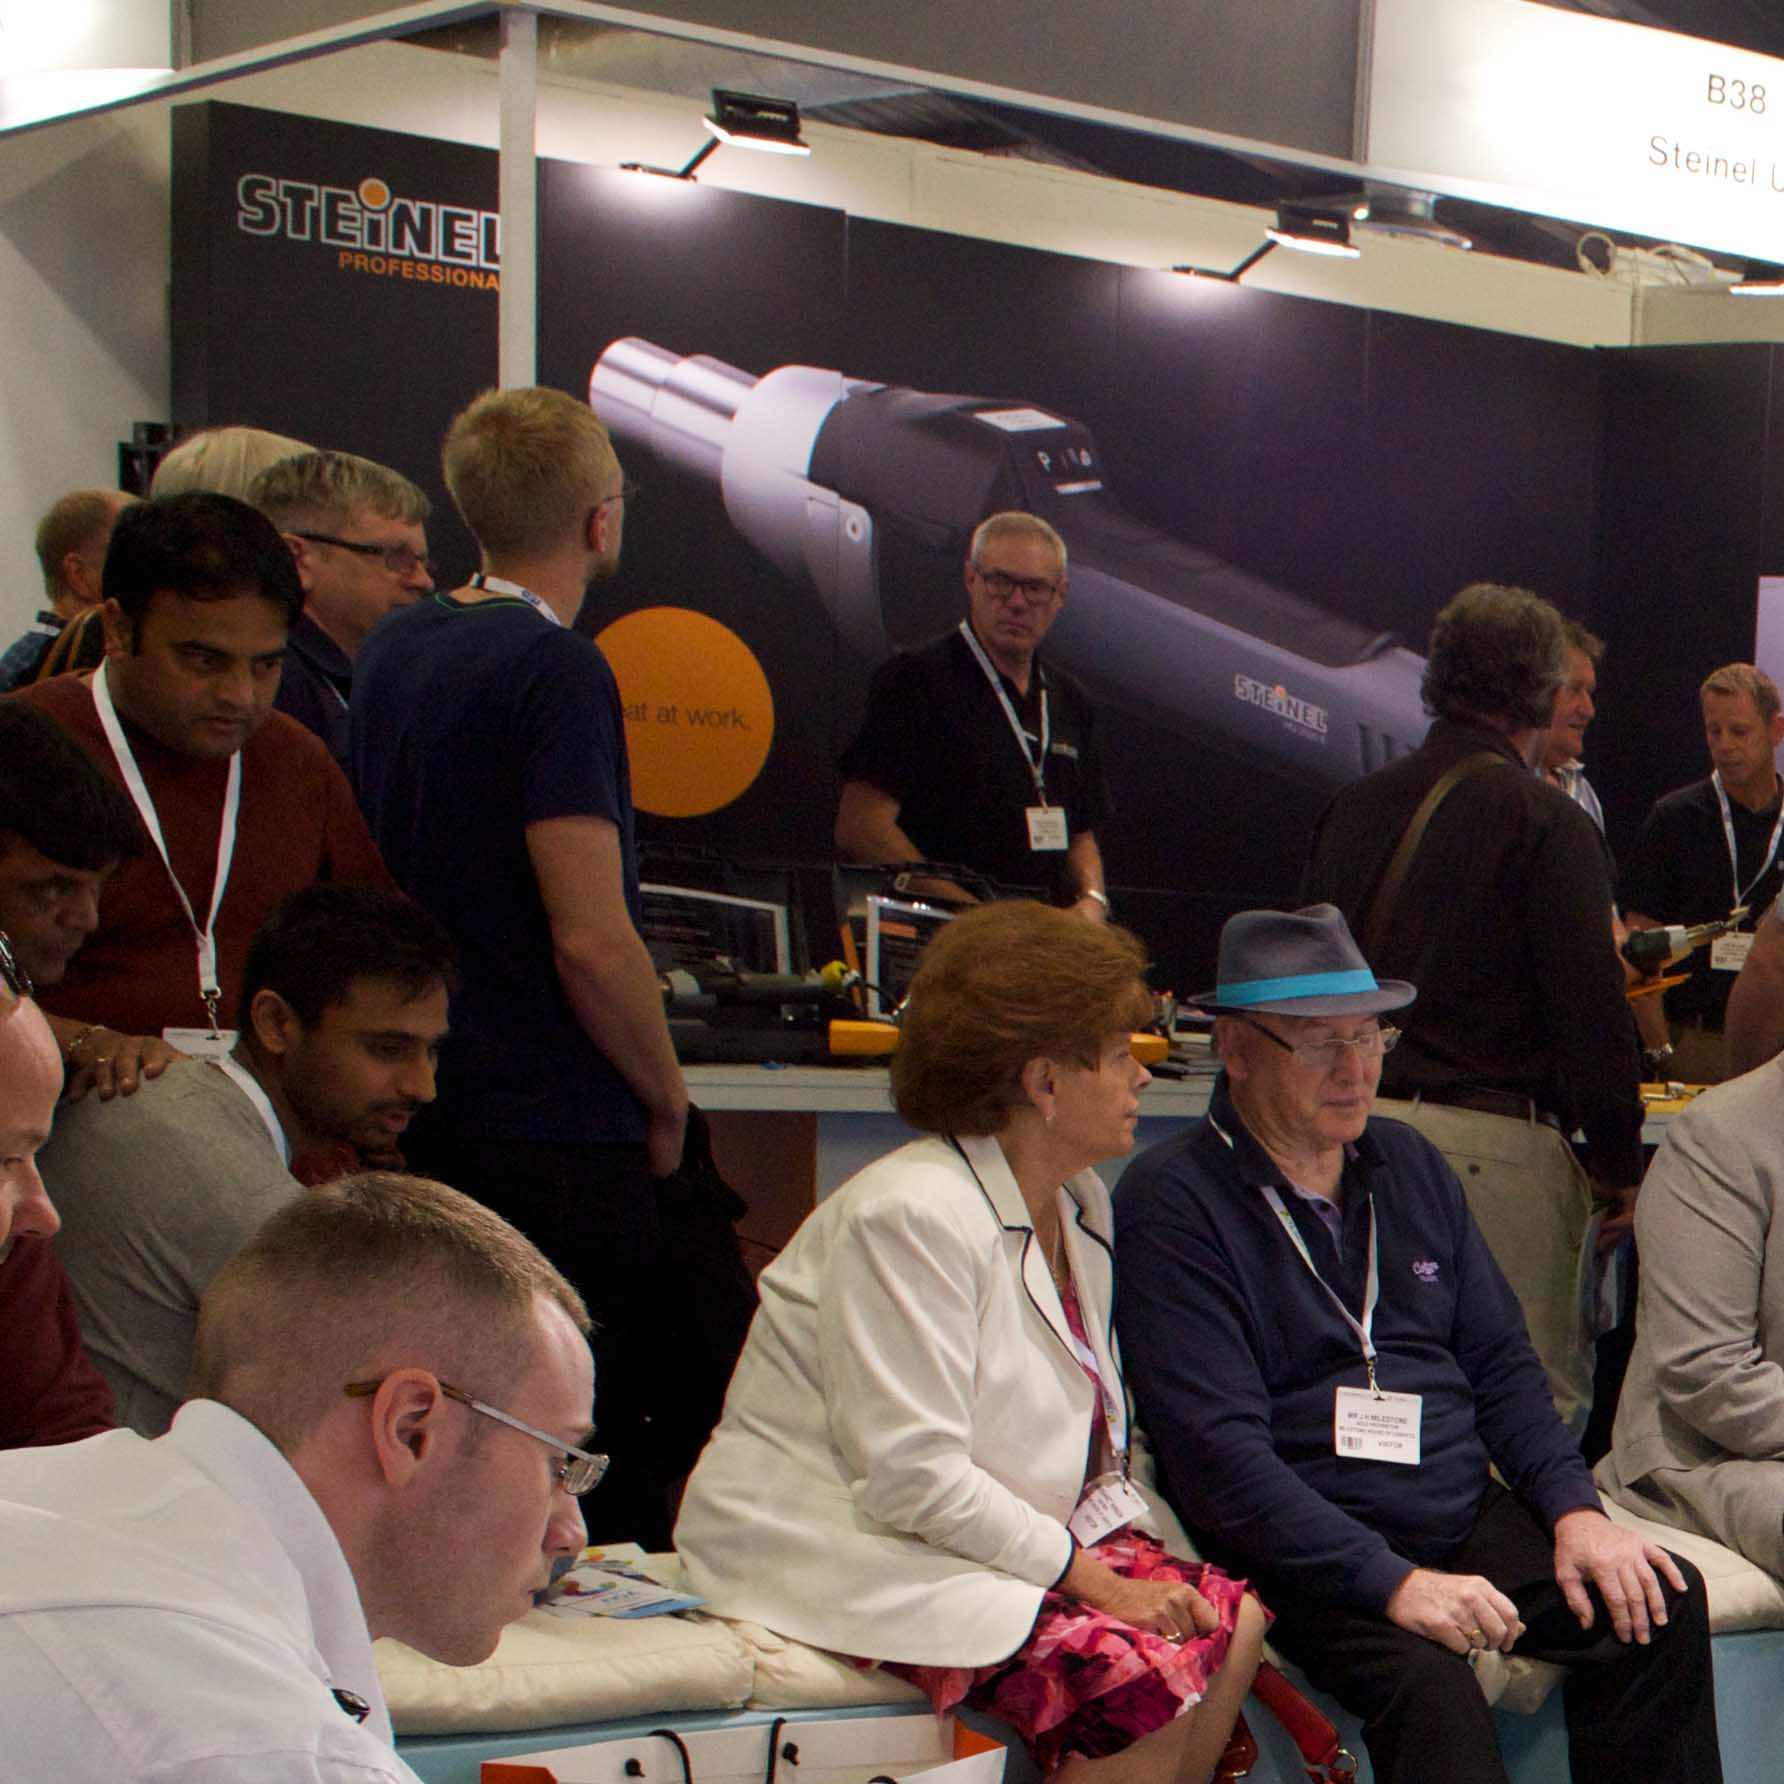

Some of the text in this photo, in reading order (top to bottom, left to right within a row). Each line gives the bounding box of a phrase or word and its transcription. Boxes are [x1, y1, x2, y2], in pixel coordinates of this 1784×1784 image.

[1707, 73, 1766, 115] B38
[1649, 135, 1757, 185] Steinel
[338, 251, 500, 291] PROFESSIONA
[656, 704, 678, 725] at
